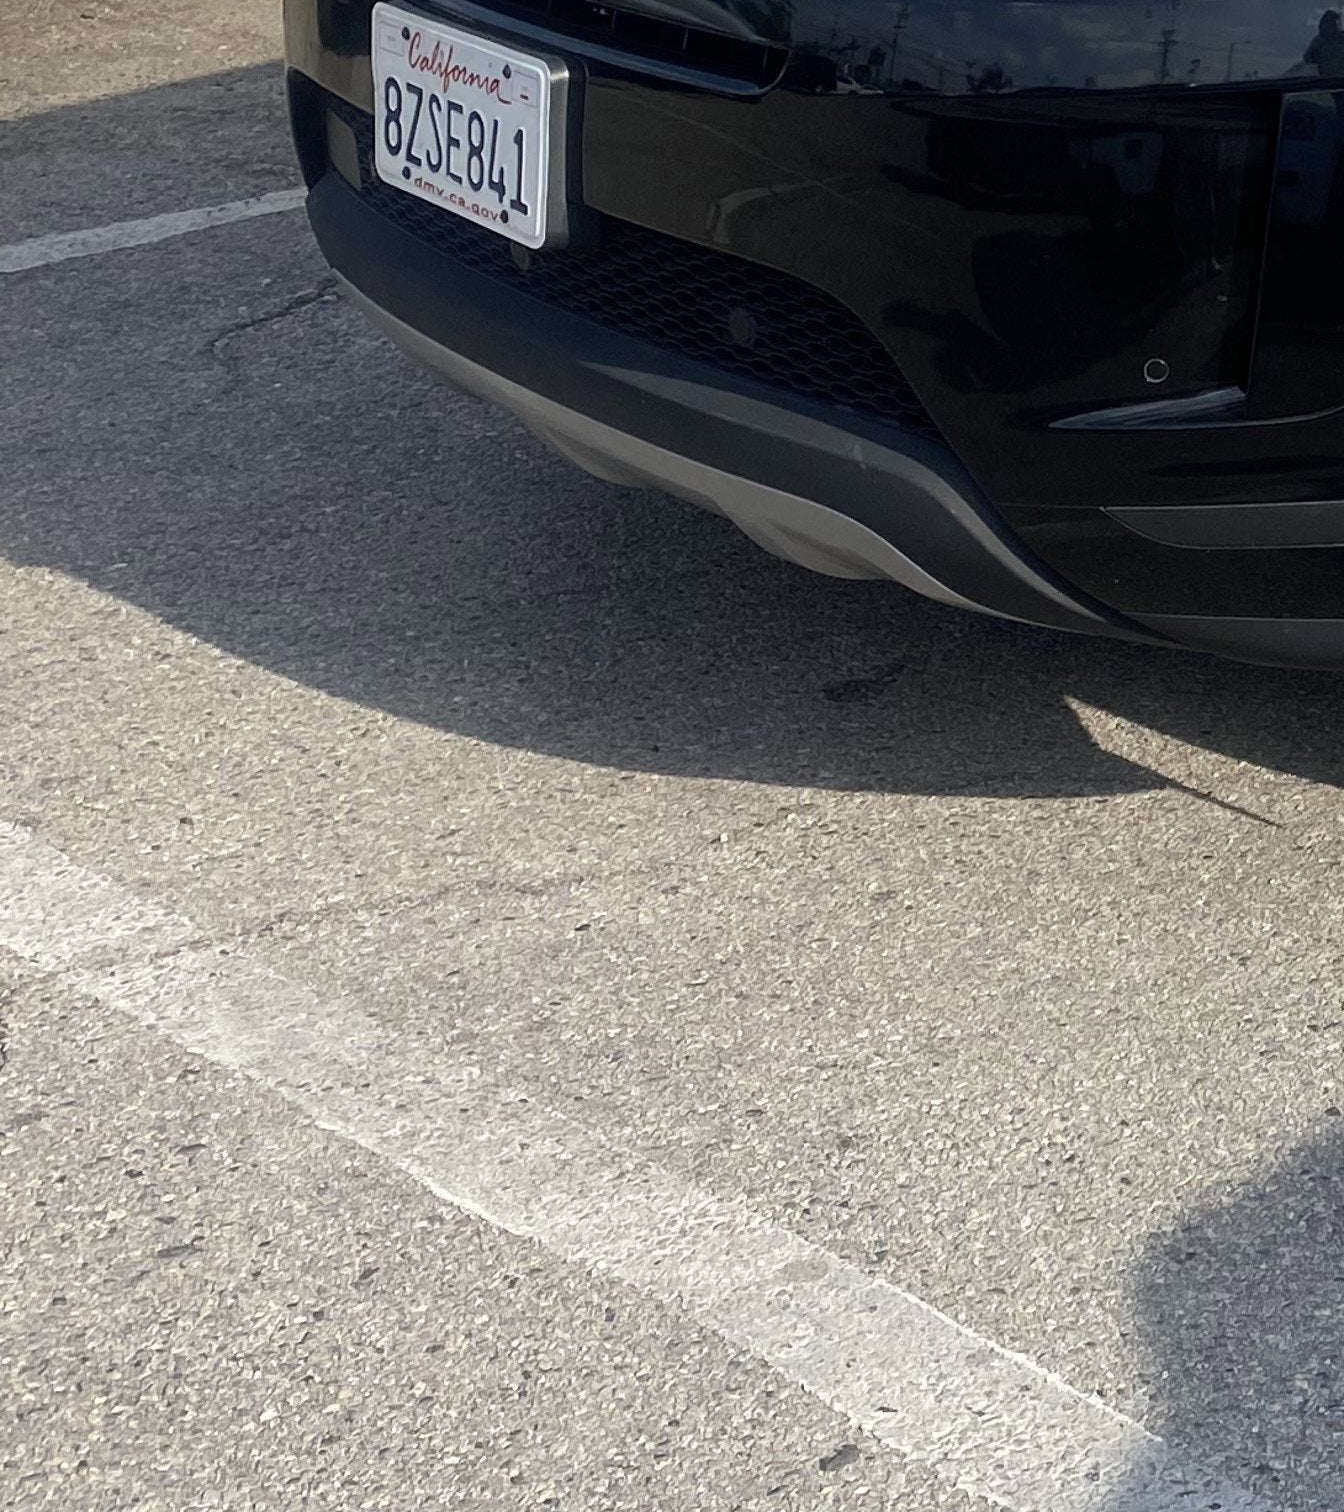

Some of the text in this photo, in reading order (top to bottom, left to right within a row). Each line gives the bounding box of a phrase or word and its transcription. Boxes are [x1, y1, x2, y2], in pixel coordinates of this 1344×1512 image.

[407, 32, 512, 105] California
[384, 76, 529, 216] 8ZSE841
[413, 176, 499, 221] dmv.ca.gov
